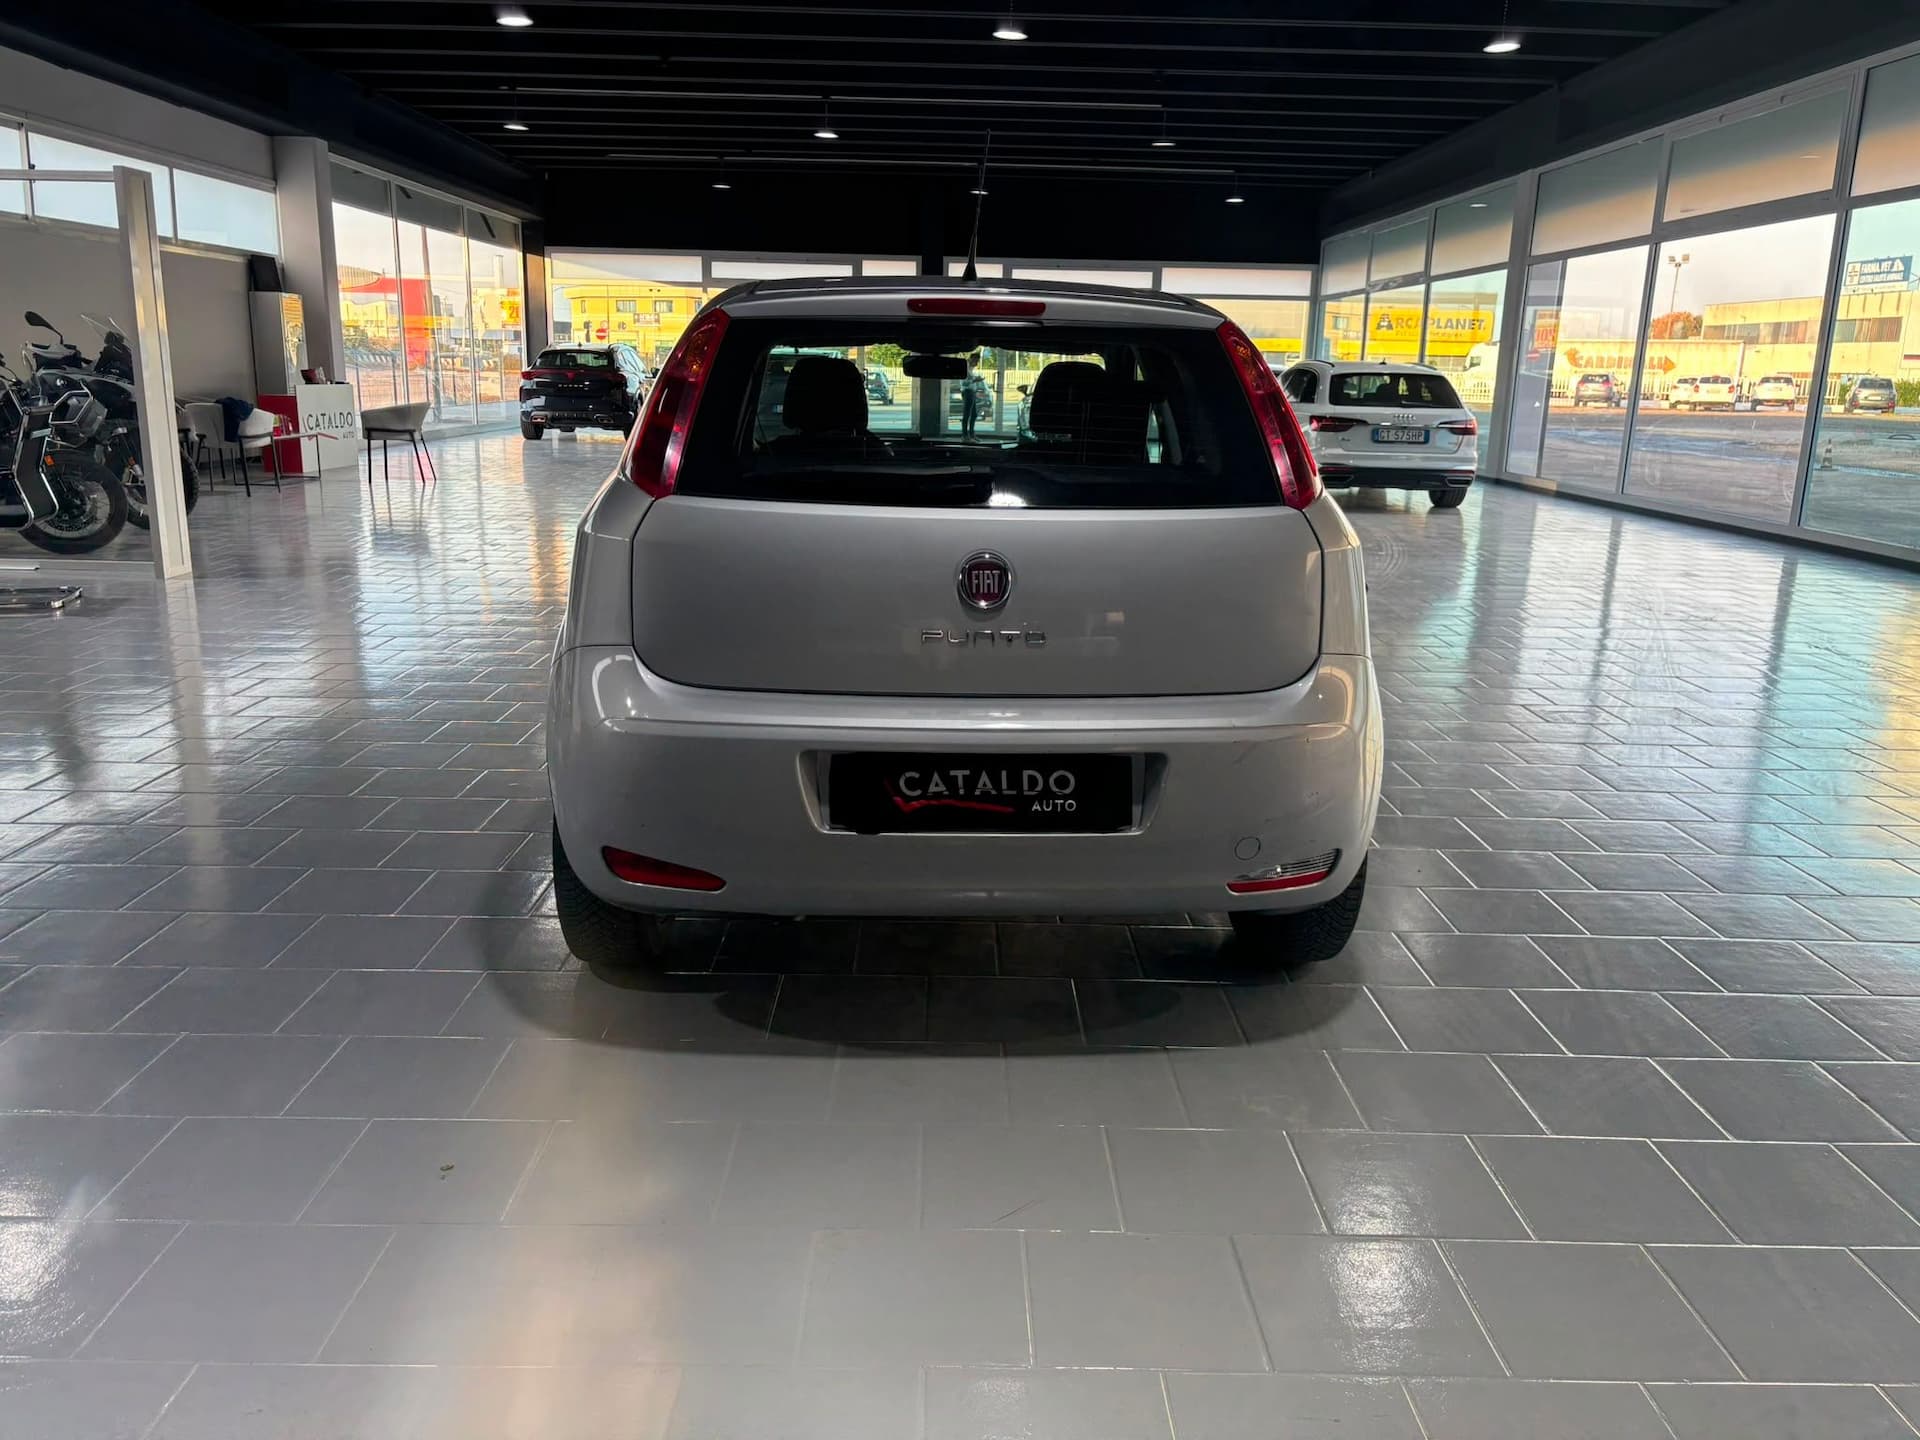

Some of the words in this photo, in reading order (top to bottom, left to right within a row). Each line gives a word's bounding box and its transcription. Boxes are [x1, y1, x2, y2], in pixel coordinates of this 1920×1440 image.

[306, 411, 354, 431] CATALDO
[971, 569, 1001, 594] FIAT
[899, 769, 1077, 797] CATALDO
[1031, 800, 1077, 813] AUTO
